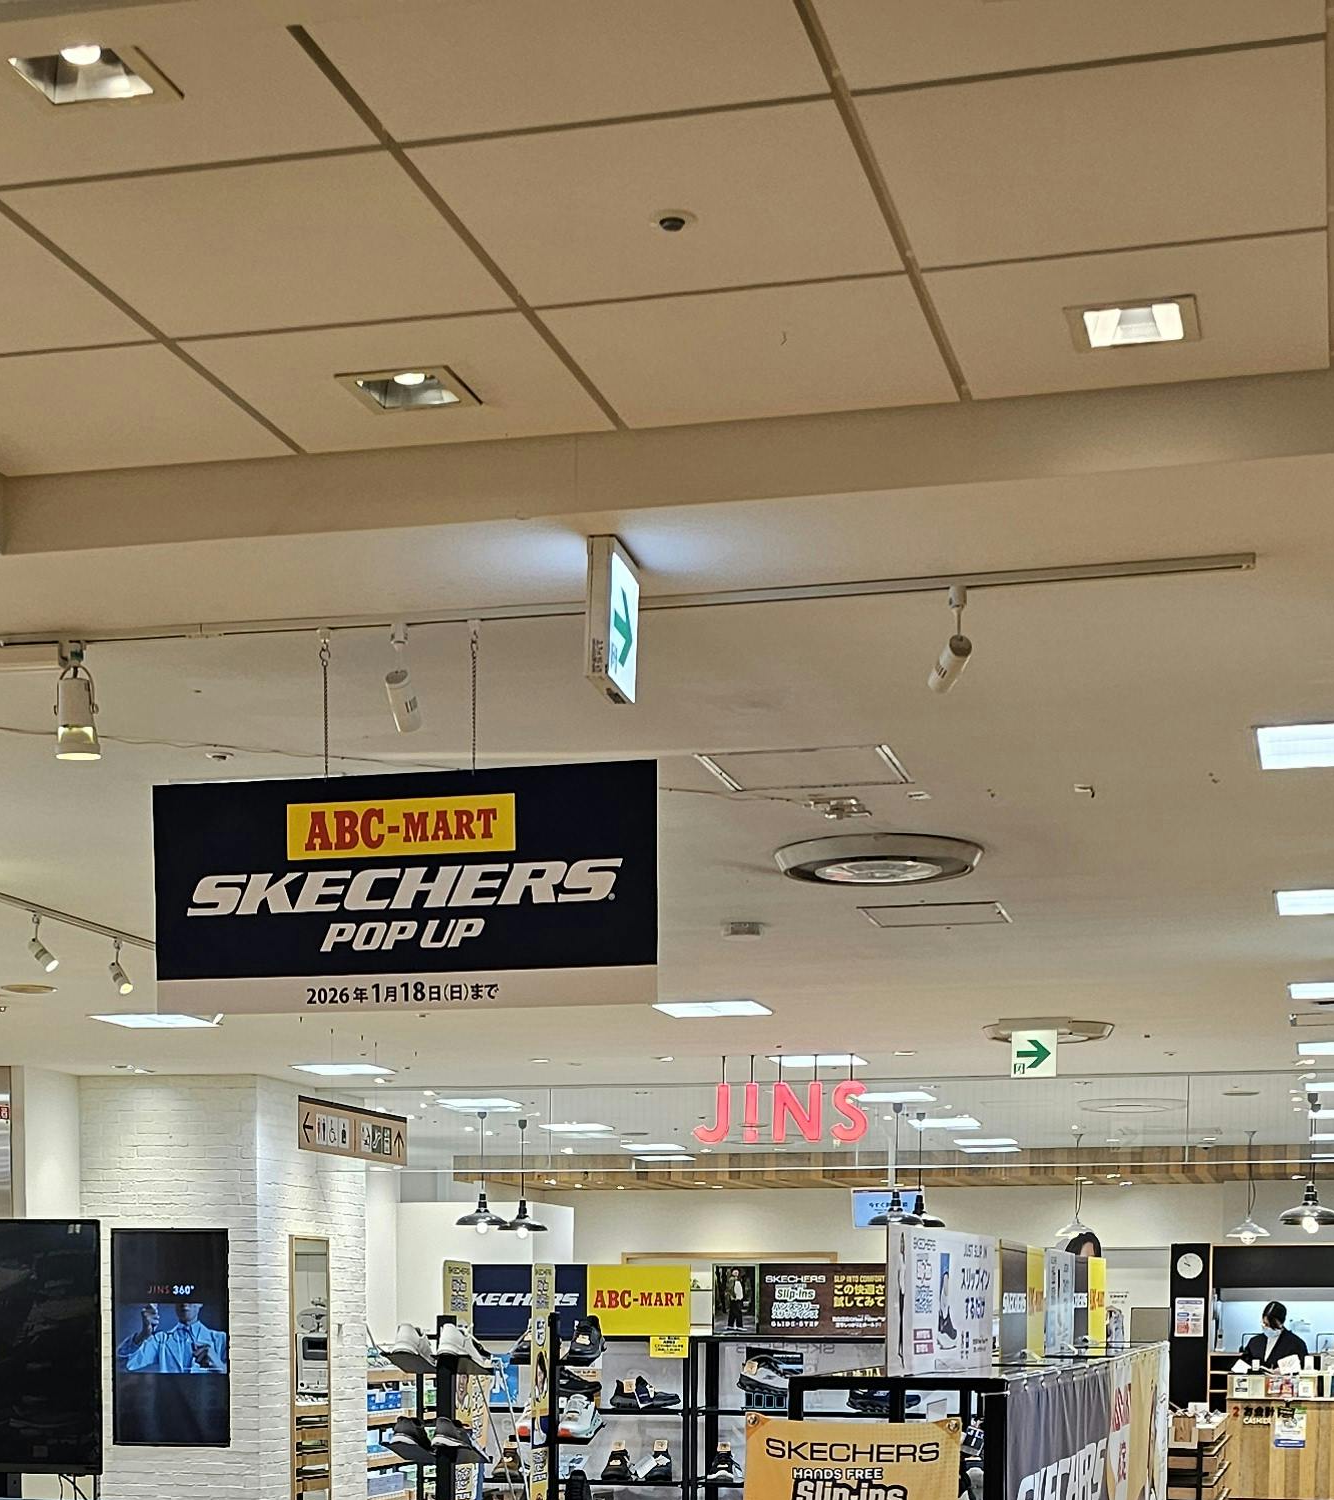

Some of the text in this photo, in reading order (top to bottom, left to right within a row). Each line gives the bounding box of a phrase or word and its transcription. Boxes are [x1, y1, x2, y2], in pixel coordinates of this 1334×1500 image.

[304, 807, 498, 852] ABC-MART
[186, 857, 623, 918] SKECHERS
[320, 917, 486, 952] POP UP
[691, 1081, 868, 1144] JINS
[147, 1285, 170, 1294] JINS
[765, 1275, 826, 1283] SKECHERS
[593, 1290, 685, 1309] ABC-MART
[765, 1437, 939, 1463] SKECHERS
[793, 1468, 883, 1480] HANDS FREE
